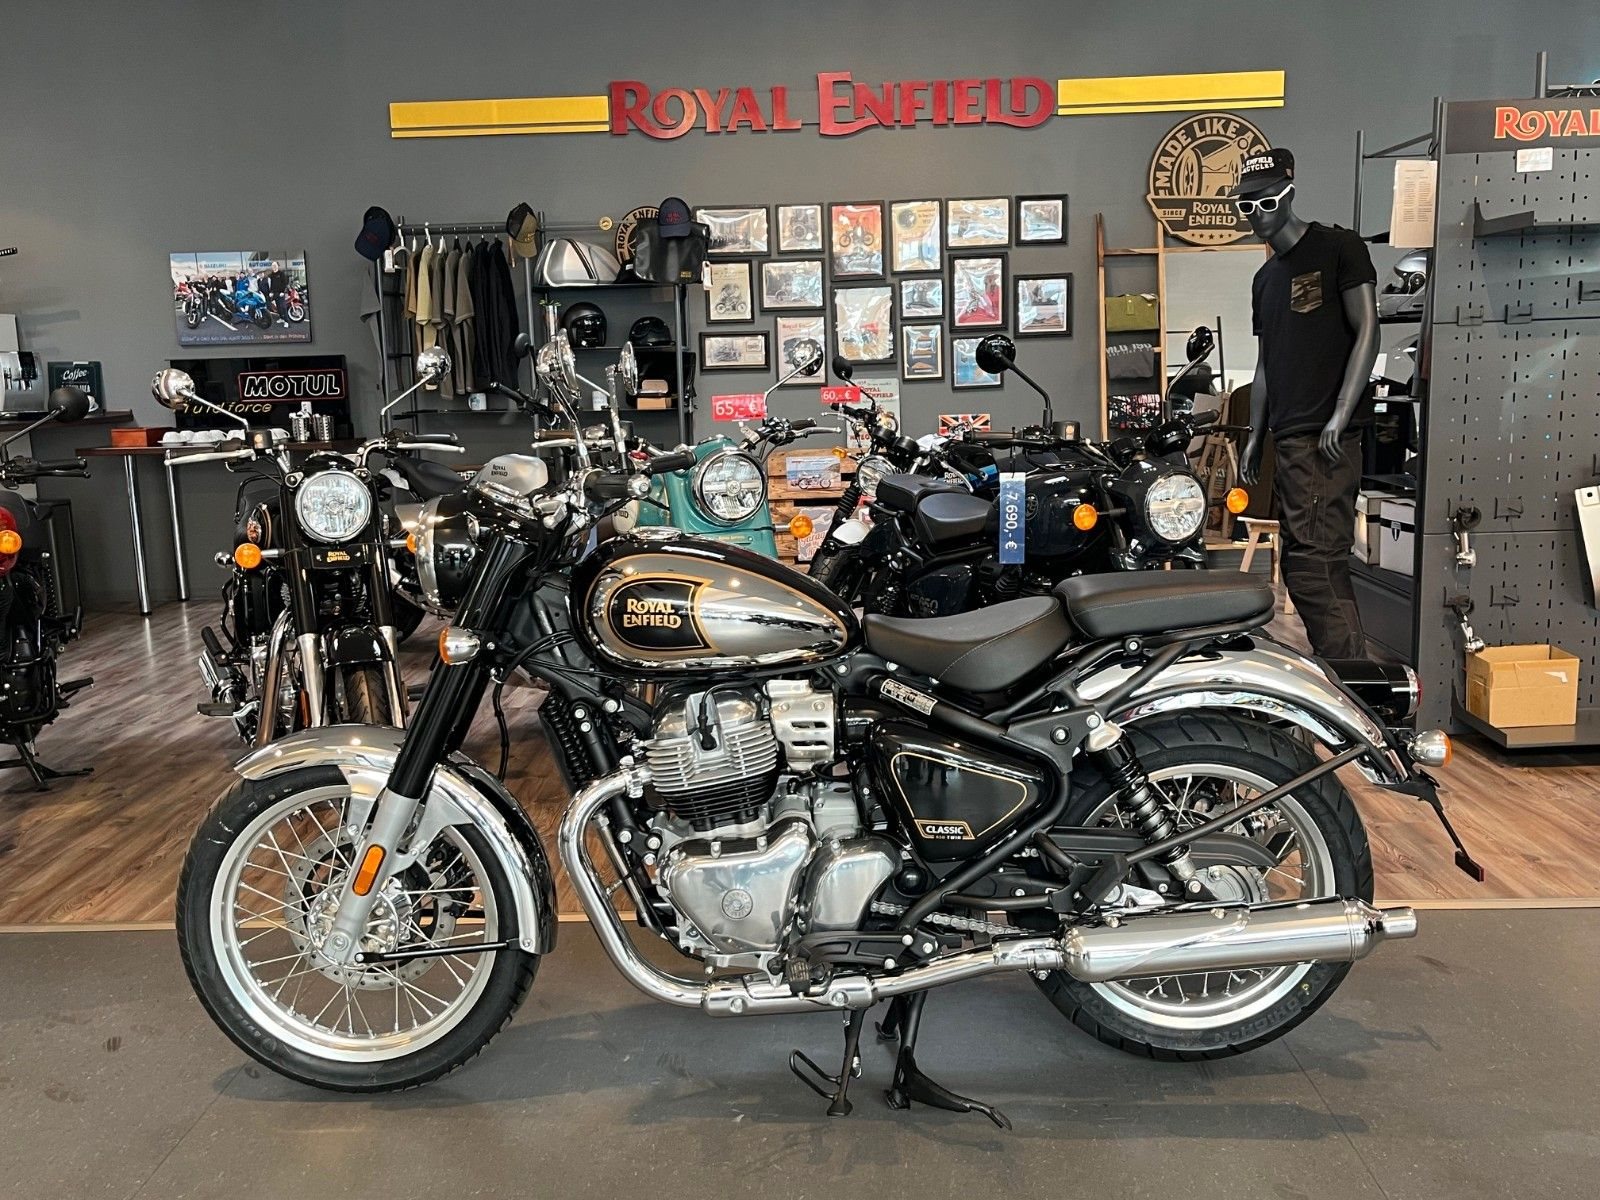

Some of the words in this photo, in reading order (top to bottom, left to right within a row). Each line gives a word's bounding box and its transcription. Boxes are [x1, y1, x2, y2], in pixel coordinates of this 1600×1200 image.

[610, 79, 801, 139] ROYAL
[817, 71, 1055, 136] ENFIELD
[1494, 106, 1600, 141] ROYAL
[1155, 129, 1192, 187] MADE
[1193, 118, 1240, 139] LIKE
[633, 209, 659, 219] ENFIE
[1192, 202, 1232, 214] ROYAL
[1188, 215, 1237, 226] ENFIELD
[63, 368, 88, 380] Coffee
[244, 374, 341, 397] MOTUL
[228, 401, 273, 413] force
[715, 401, 744, 418] 65,-
[1003, 493, 1018, 538] 7.690,-
[1005, 541, 1018, 550] €
[626, 598, 675, 614] ROYAL
[623, 614, 682, 629] ENFIELD
[925, 825, 964, 834] CLASSIC
